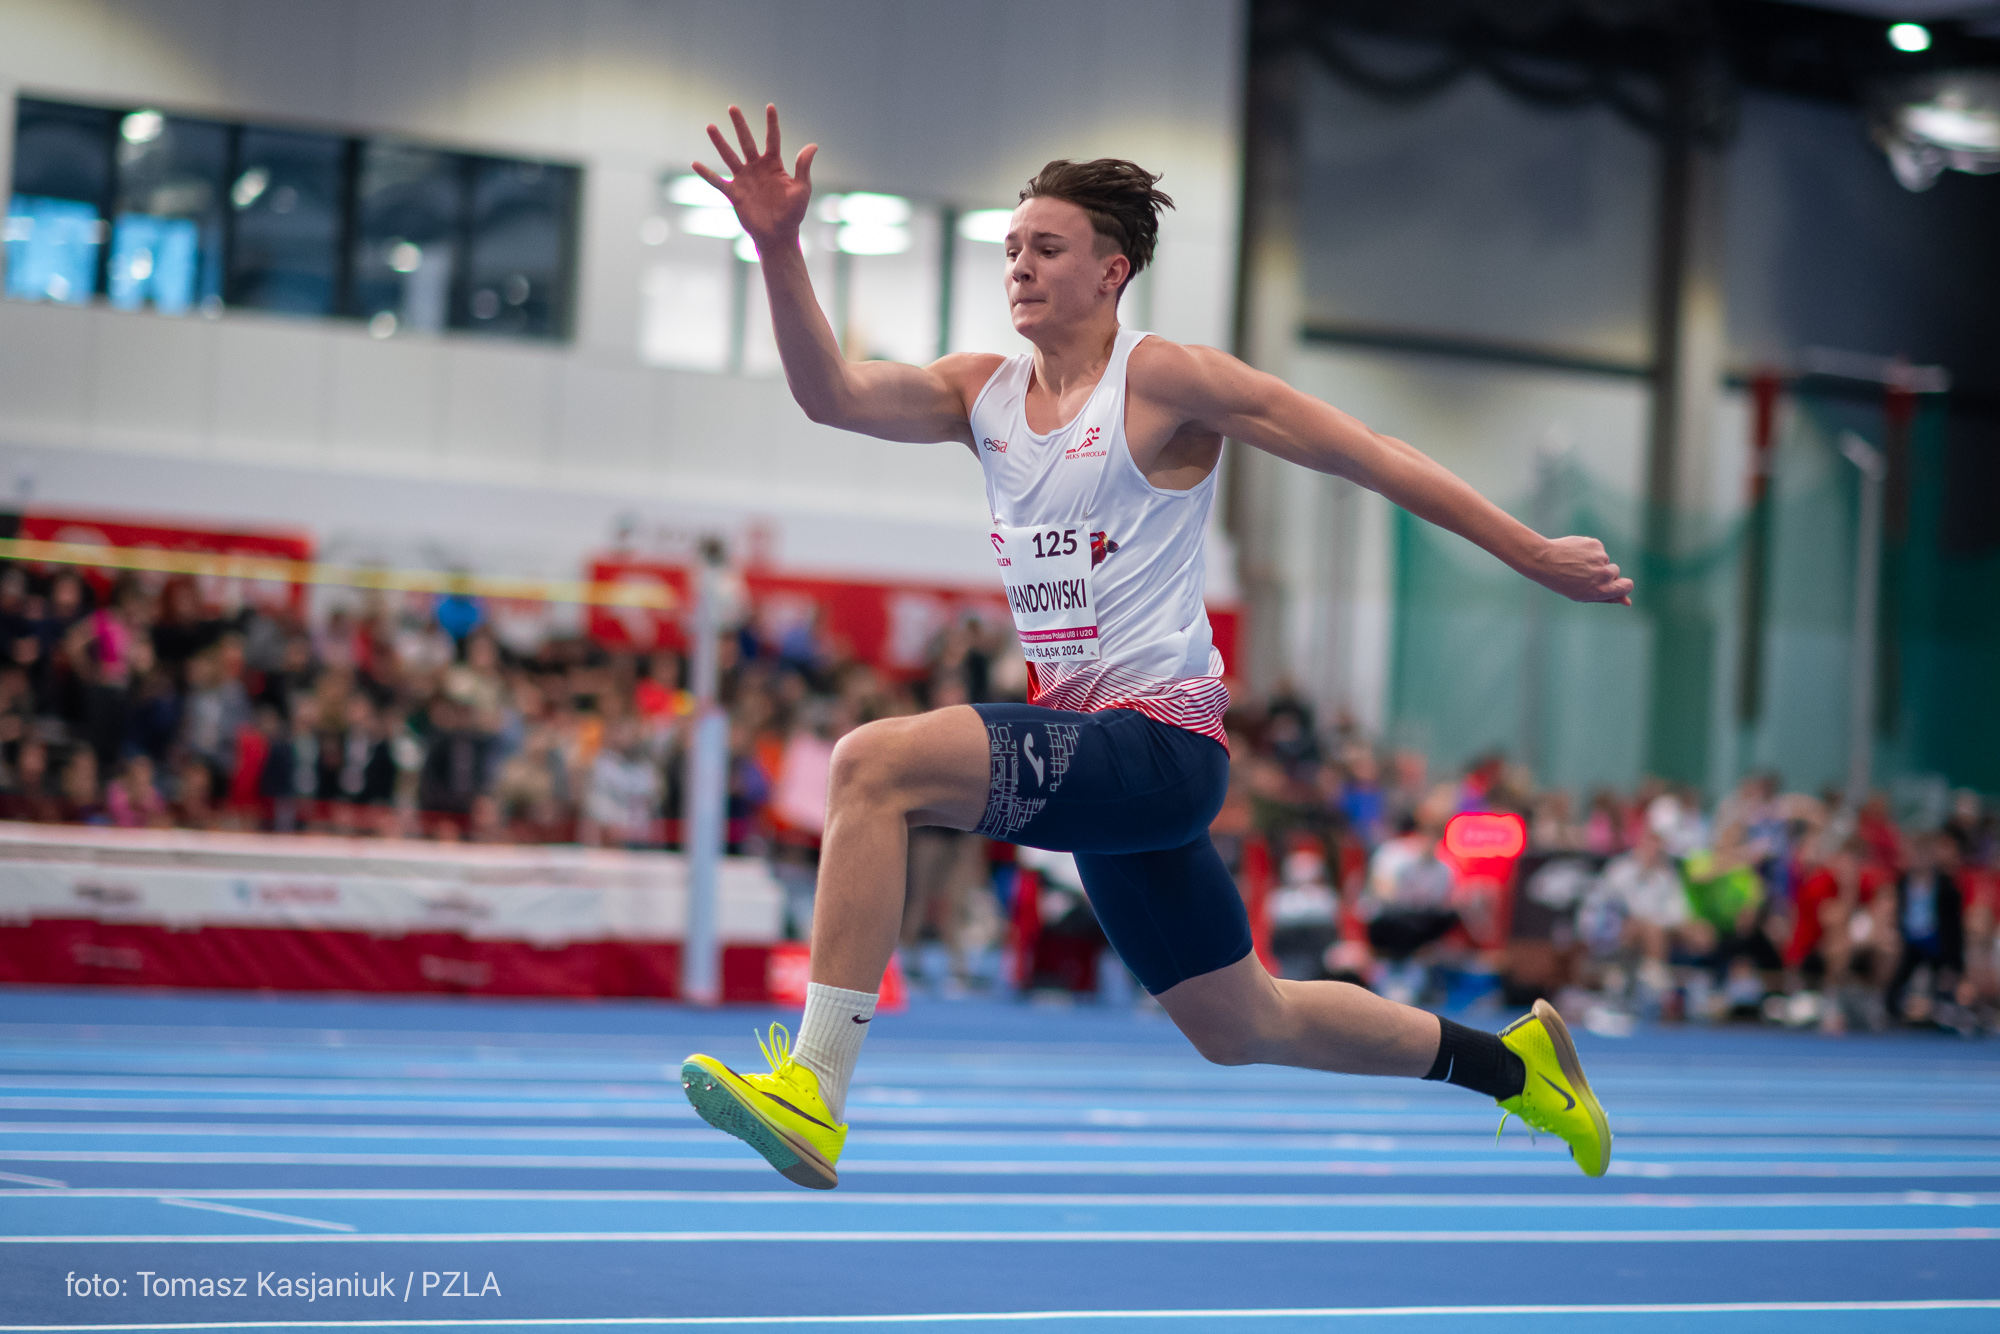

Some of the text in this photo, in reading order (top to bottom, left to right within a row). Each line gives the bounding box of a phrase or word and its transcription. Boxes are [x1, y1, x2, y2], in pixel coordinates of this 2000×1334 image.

[983, 437, 1008, 453] esa
[1032, 529, 1078, 558] 125
[1066, 630, 1076, 638] U18
[1079, 629, 1094, 637] U20
[1036, 645, 1061, 659] ŚLĄSK
[1062, 644, 1084, 656] 2024
